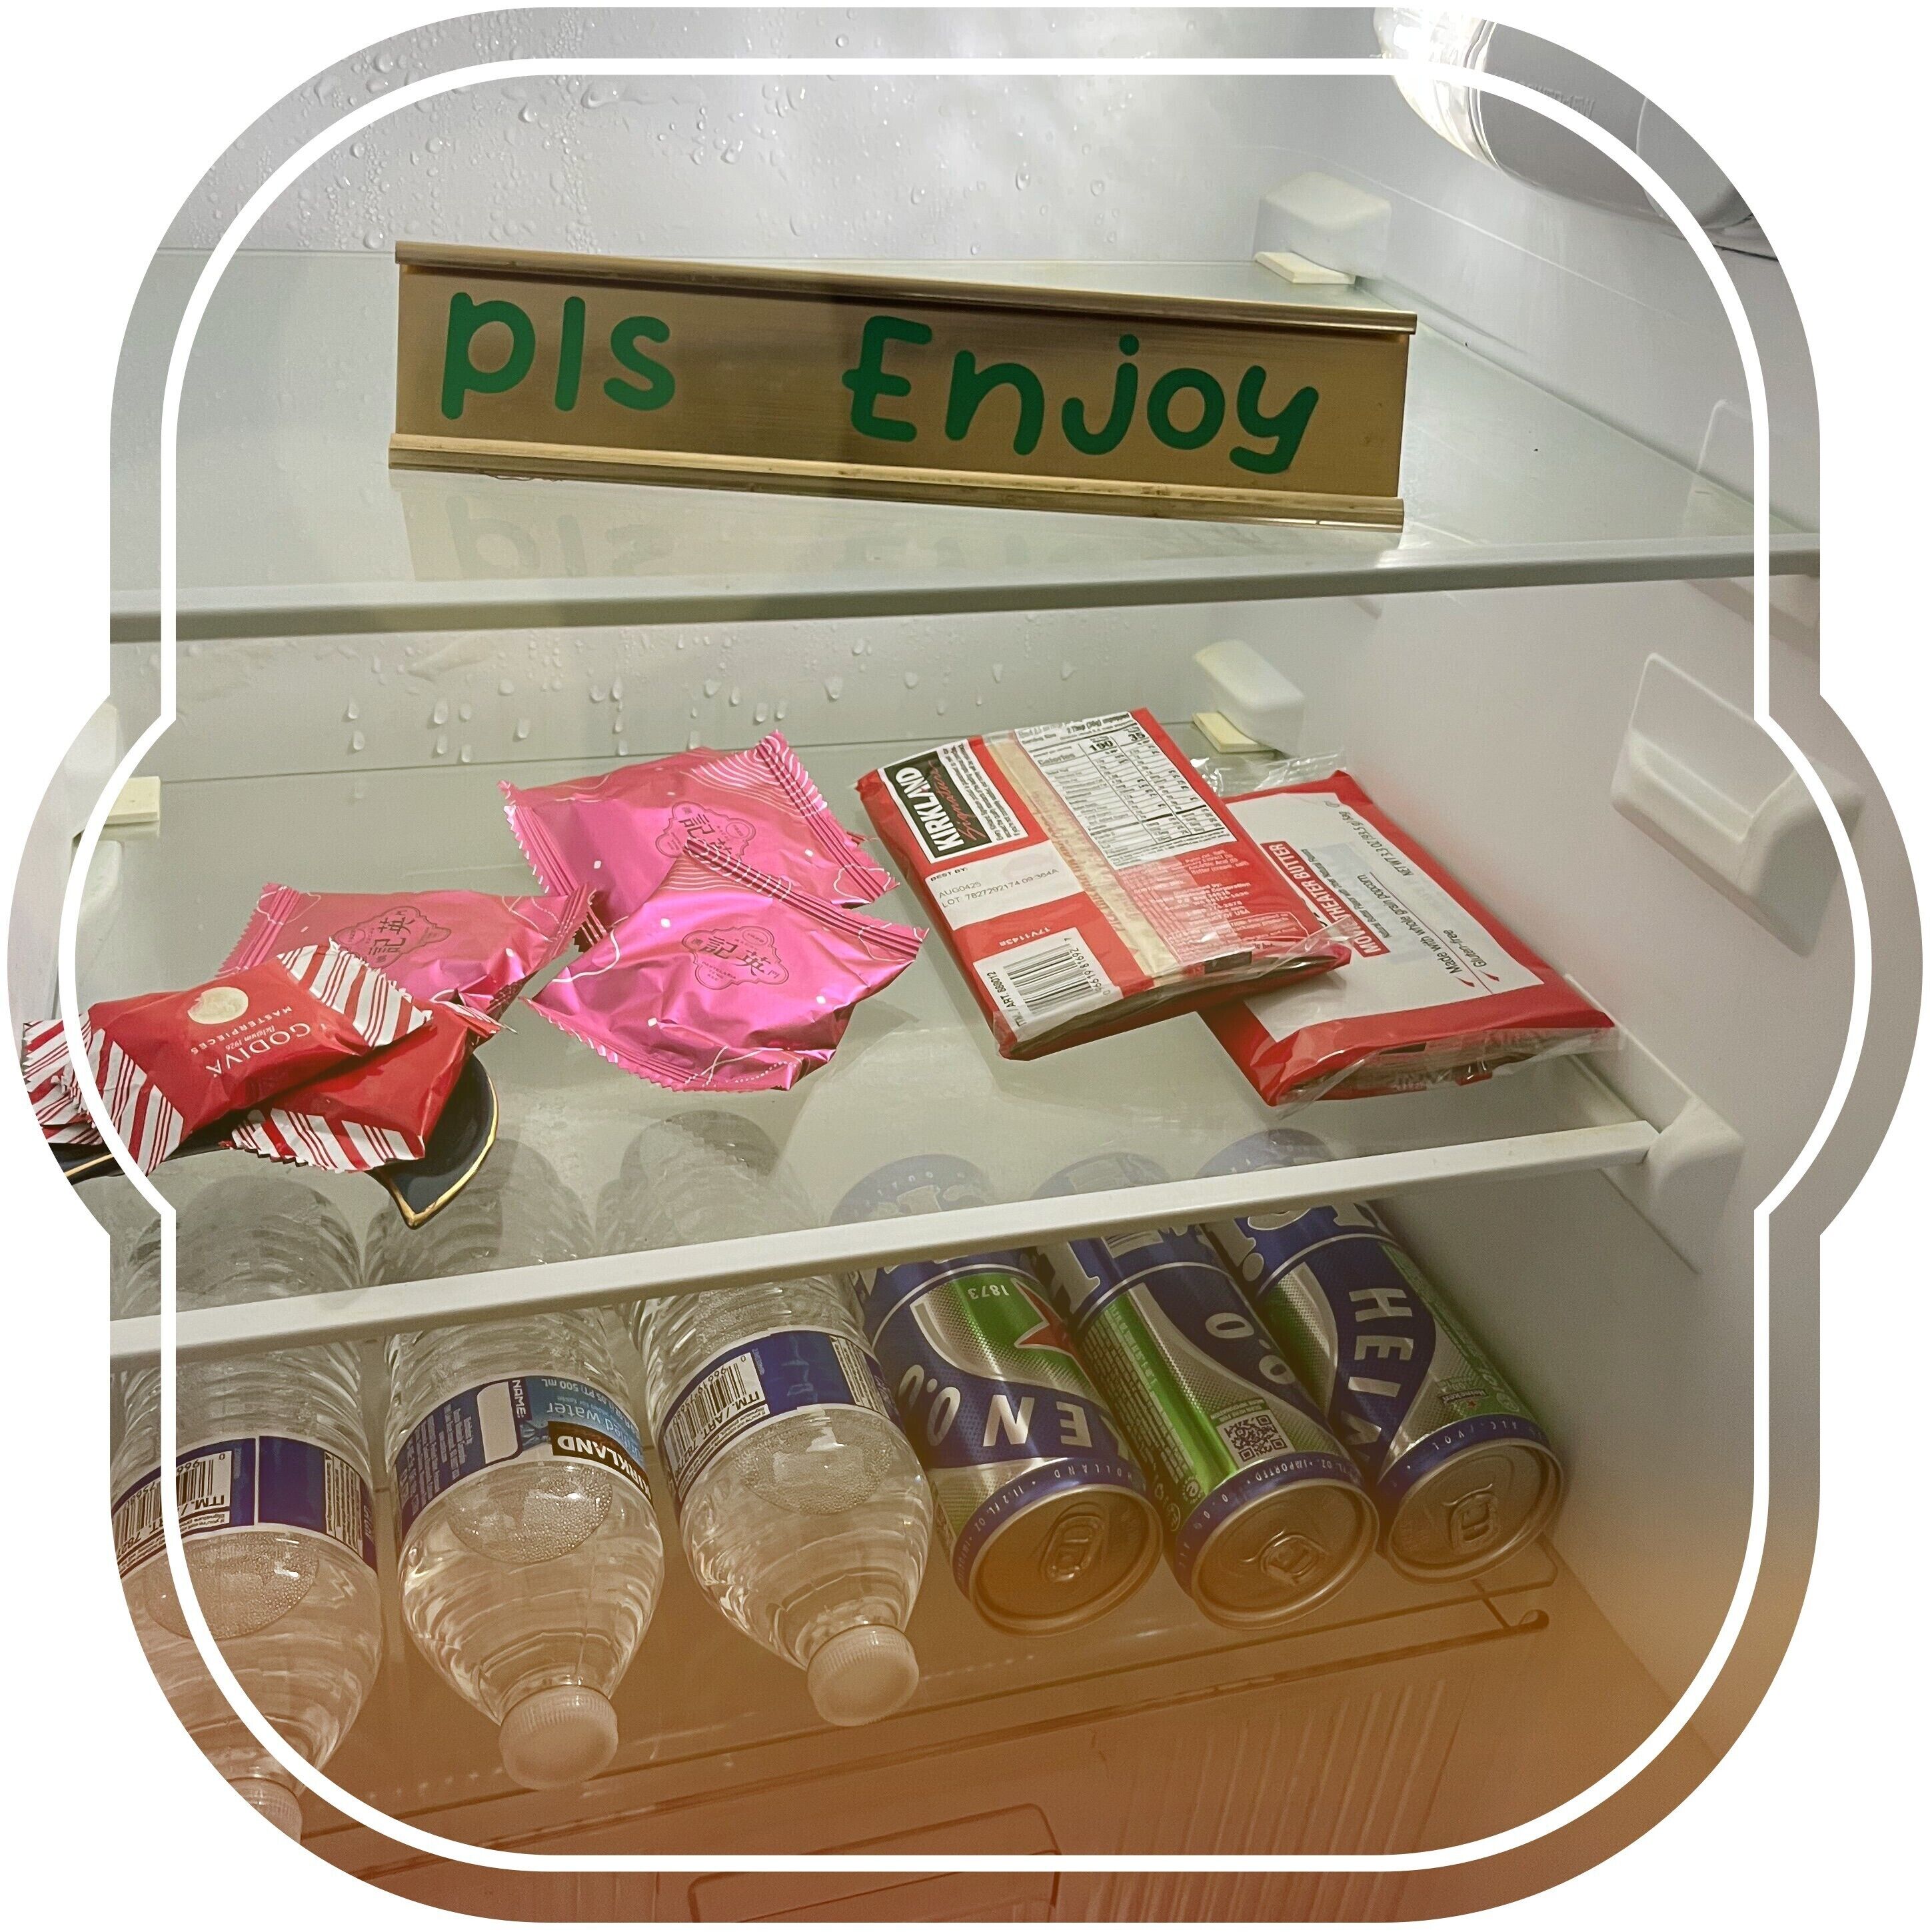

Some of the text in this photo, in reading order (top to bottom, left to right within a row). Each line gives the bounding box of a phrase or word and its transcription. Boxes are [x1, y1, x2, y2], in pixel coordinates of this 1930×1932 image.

[441, 292, 1319, 474] pls Enjoy
[896, 767, 964, 852] KIRKLAND
[928, 760, 986, 840] Signature
[1268, 843, 1311, 880] BUTTER
[930, 870, 952, 882] BEST
[942, 896, 960, 908] LOT
[1301, 880, 1351, 921] THEATER
[1400, 916, 1426, 936] whole
[1421, 936, 1441, 953] with
[1443, 930, 1487, 968] Gluten-free
[1437, 952, 1463, 974] Made
[191, 1006, 292, 1055] MASTERPIECES
[206, 1023, 311, 1074] GODIVA
[968, 1284, 1010, 1300] 1873
[560, 1380, 579, 1392] 500
[732, 1391, 760, 1411] ITM.
[546, 1402, 601, 1424] water
[700, 1414, 723, 1440] ART.
[557, 1436, 652, 1500] KIRKLAND
[1054, 1463, 1133, 1481] HOLLAND
[1255, 1459, 1308, 1481] IMPORTED
[191, 1495, 225, 1510] ITM.
